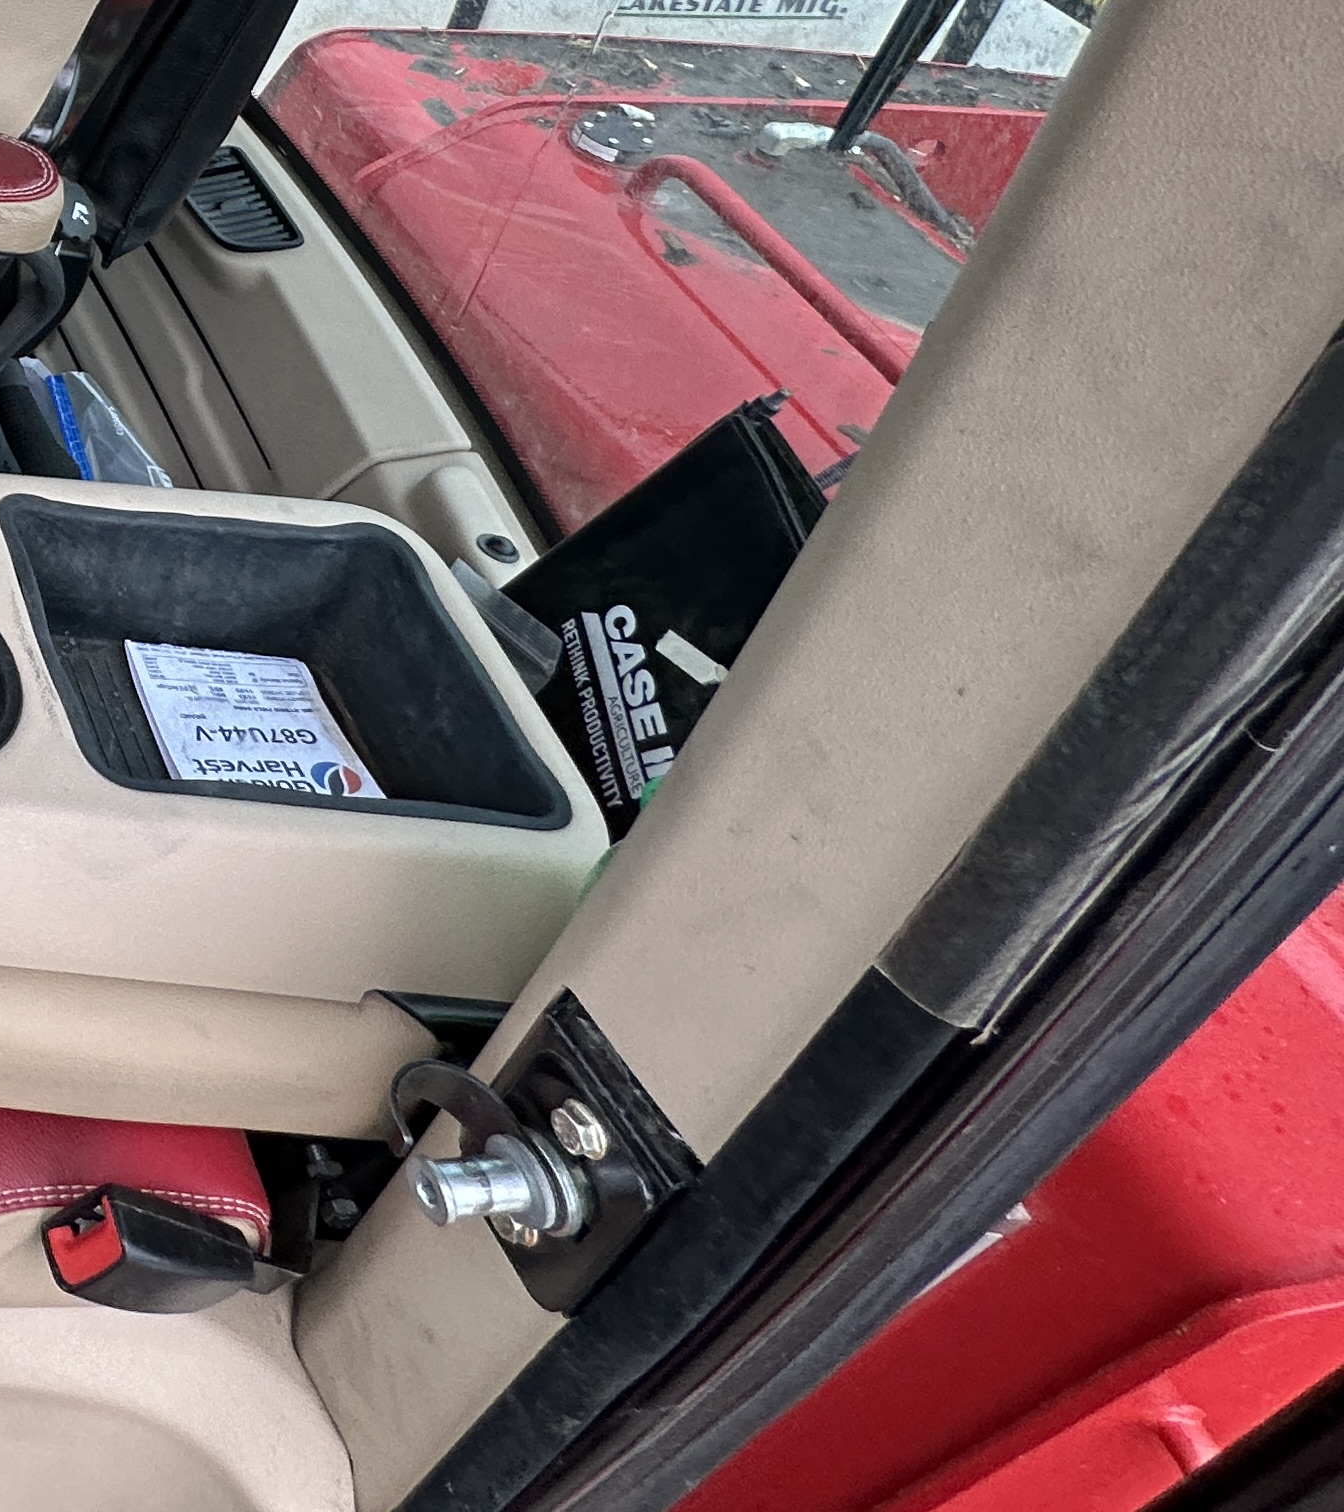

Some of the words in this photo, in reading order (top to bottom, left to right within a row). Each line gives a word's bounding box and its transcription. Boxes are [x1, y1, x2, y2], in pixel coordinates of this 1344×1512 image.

[562, 618, 591, 688] RETHINK
[579, 687, 624, 808] PRODUCTIVITY
[605, 604, 668, 741] CASE
[192, 758, 305, 778] Harvest
[196, 725, 317, 745] G87U44-V
[607, 695, 643, 794] AGRICULTURE
